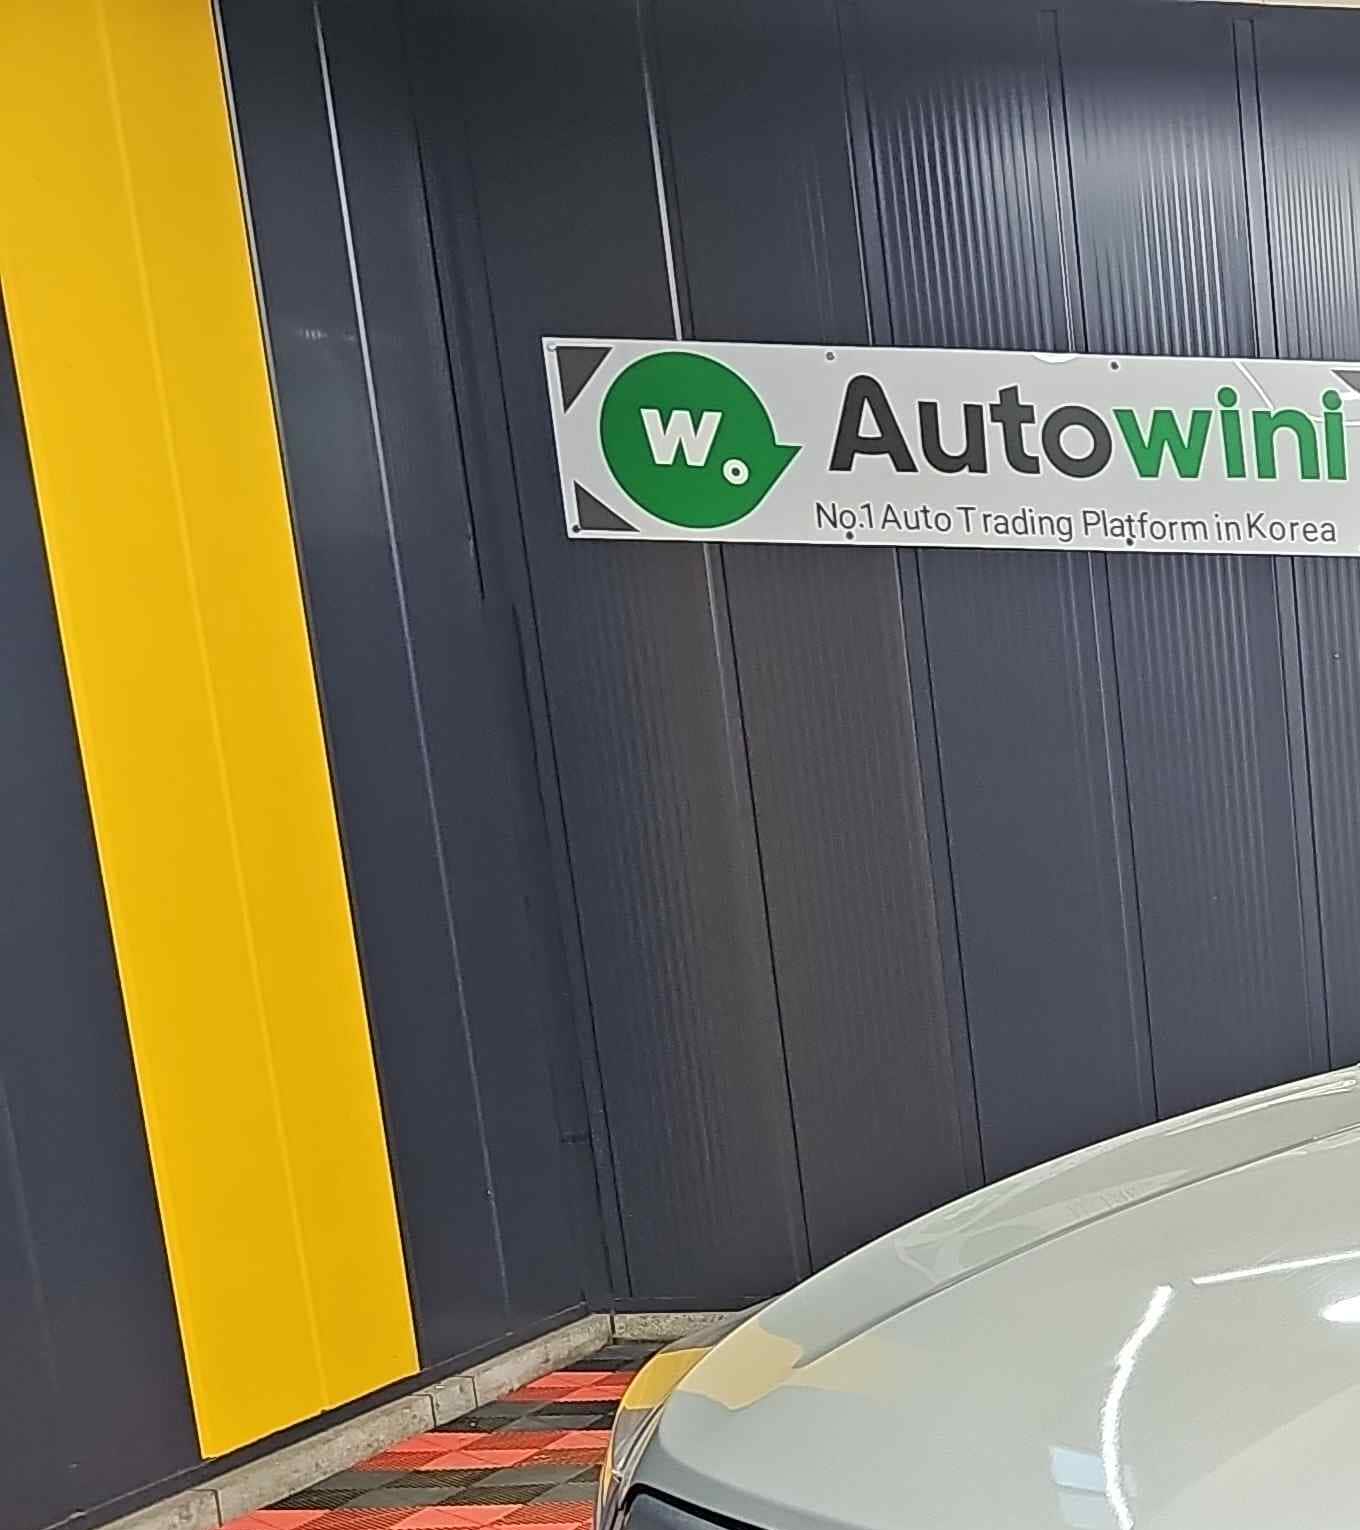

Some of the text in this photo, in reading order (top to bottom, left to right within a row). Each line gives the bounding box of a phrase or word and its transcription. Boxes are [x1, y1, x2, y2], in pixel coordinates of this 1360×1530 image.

[828, 374, 1348, 481] Autowini
[815, 502, 1338, 543] No.1 Auto Trading Platform in Korea
